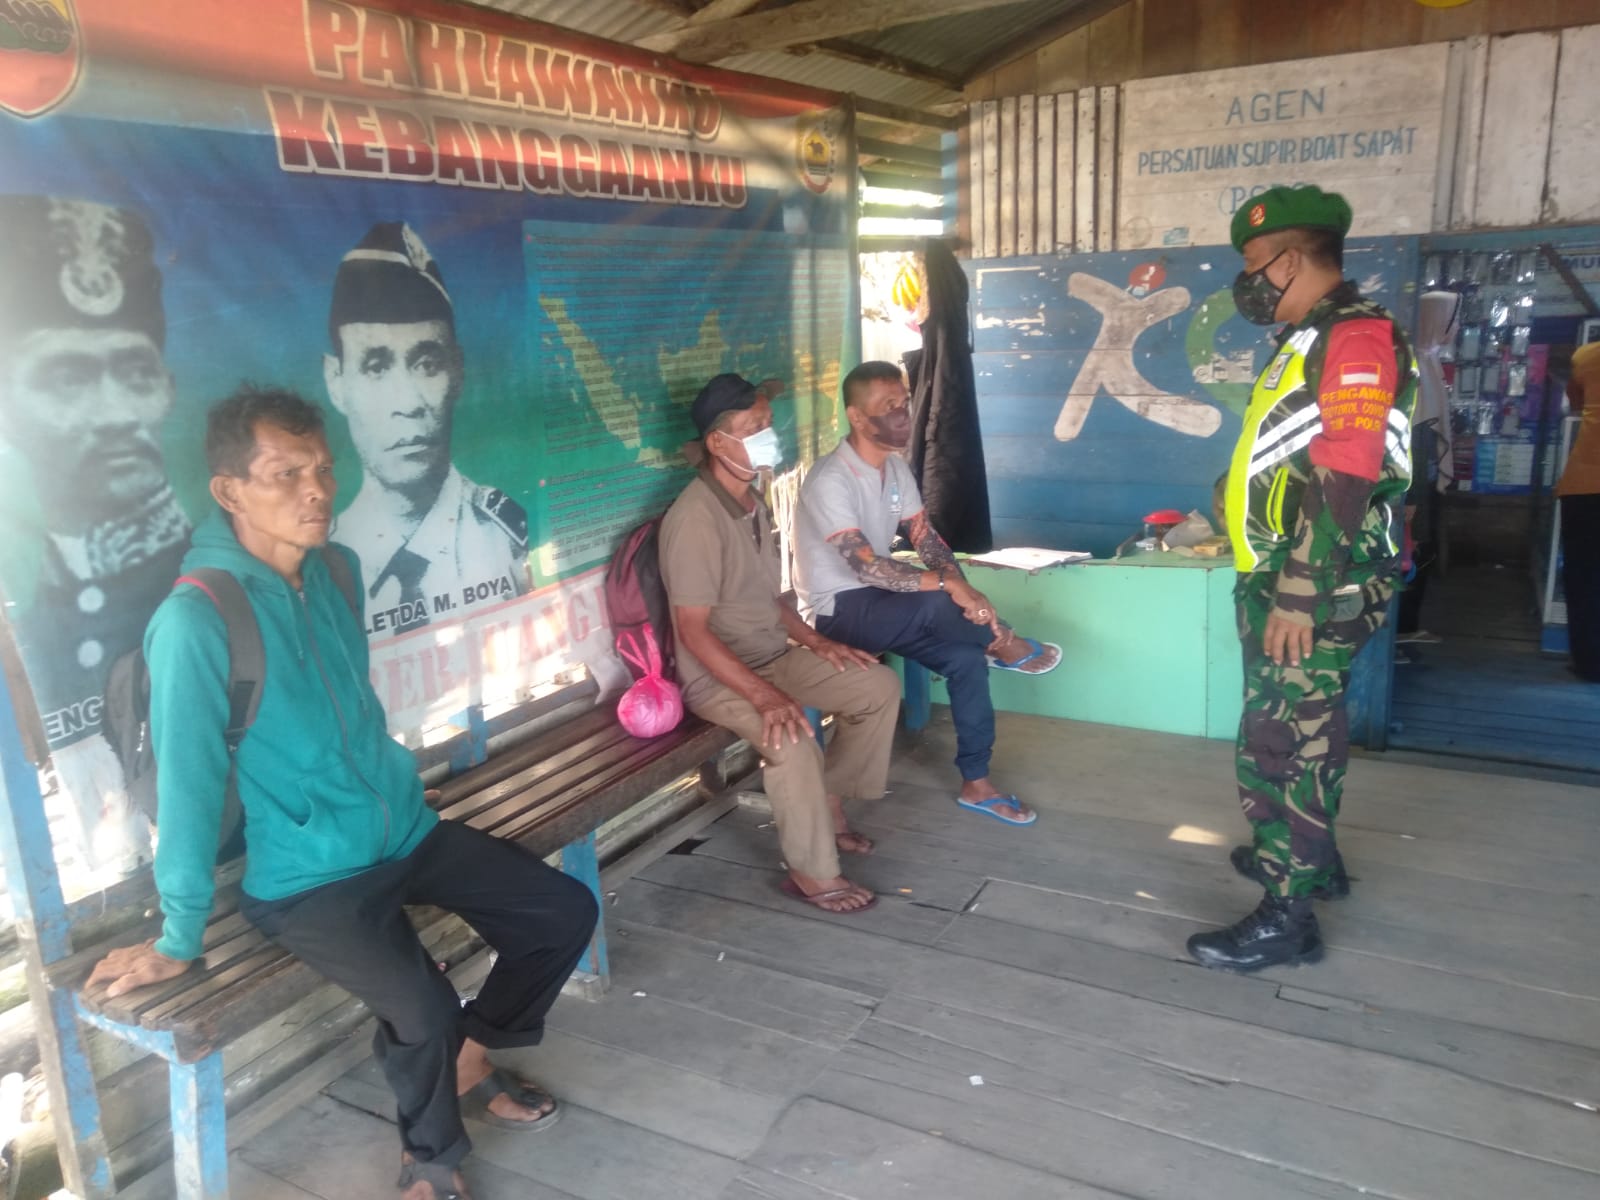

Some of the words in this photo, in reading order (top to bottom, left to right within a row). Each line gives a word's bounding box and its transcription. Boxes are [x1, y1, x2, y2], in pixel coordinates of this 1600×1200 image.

[303, 0, 722, 141] PAHLAWANKU
[1225, 87, 1326, 126] AGEN
[263, 85, 747, 209] KEBANGGAANKU
[1137, 147, 1238, 176] PERSATUAN
[1242, 141, 1297, 168] SUPIR
[1301, 133, 1351, 163] BOAT
[1353, 127, 1418, 159] SAPAT
[1321, 386, 1394, 406] PENGAWAS
[365, 600, 428, 635] ETDA
[433, 592, 457, 614] M.
[464, 576, 513, 606] BOYA
[41, 694, 105, 744] ENG
